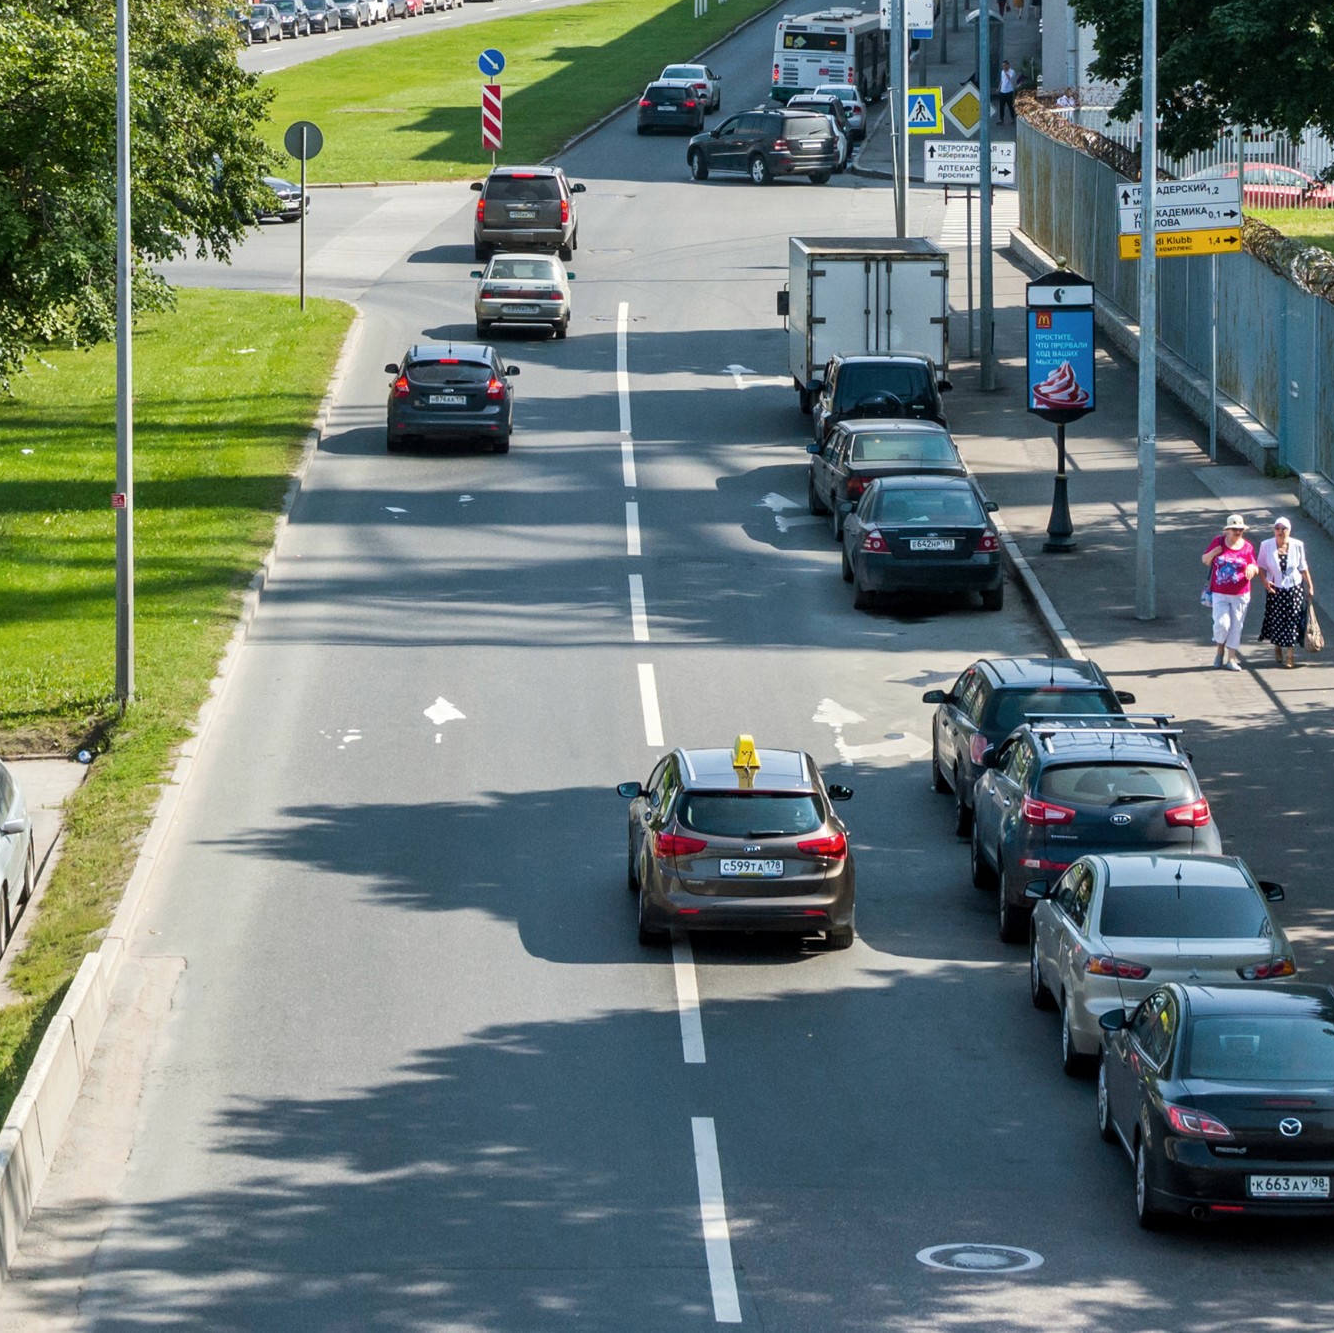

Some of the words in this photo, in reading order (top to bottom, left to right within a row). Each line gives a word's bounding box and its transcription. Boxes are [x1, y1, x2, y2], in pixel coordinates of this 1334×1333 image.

[1000, 149, 1012, 157] 1,2
[938, 164, 998, 172] АПТЕКАРСЙ
[1132, 183, 1207, 196] ГРАДЕРСКИЙ
[1207, 187, 1219, 195] 1,2
[1208, 211, 1221, 219] 0,1
[1135, 218, 1180, 228] ПЛОВА
[1167, 235, 1192, 245] Klubb
[1208, 237, 1220, 245] 1,4
[1035, 333, 1074, 341] ПРОСТИТЕ,
[723, 860, 764, 872] С599ТА
[765, 860, 781, 869] 178
[1256, 1177, 1308, 1191] К663АУ
[1311, 1177, 1325, 1188] 98
